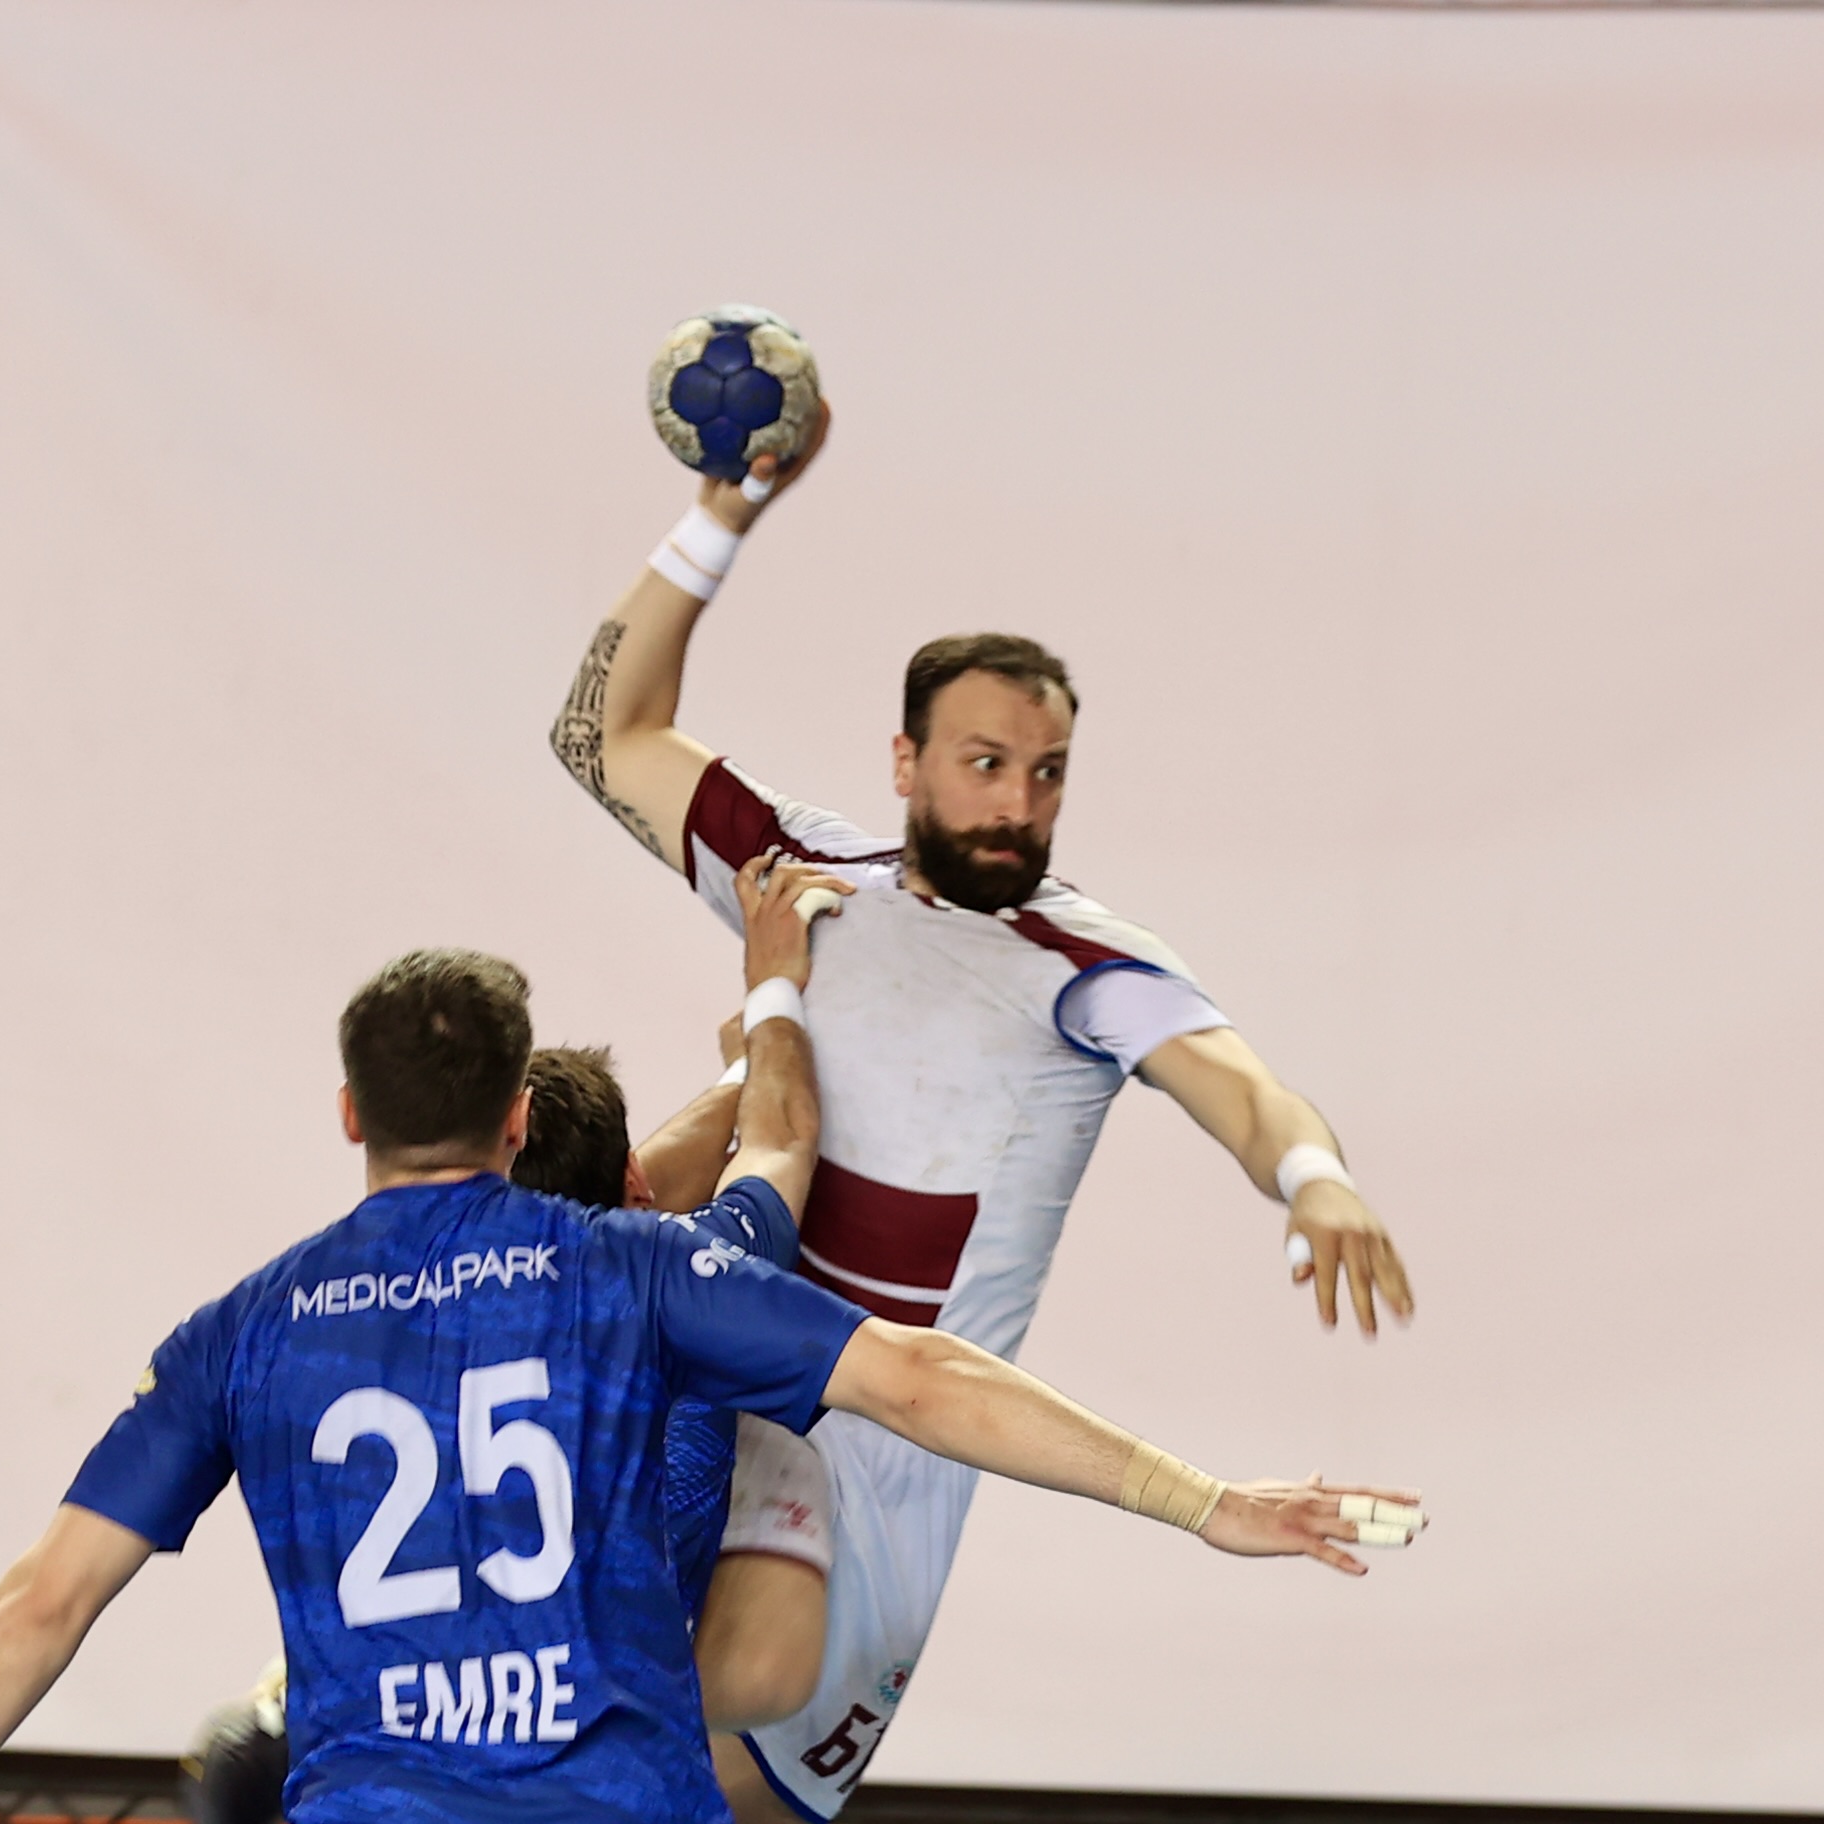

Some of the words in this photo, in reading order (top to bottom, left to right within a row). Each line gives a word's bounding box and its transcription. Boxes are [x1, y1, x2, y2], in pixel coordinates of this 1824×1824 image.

[292, 1242, 561, 1323] MEDICALPARK
[311, 1356, 576, 1631] 25
[379, 1643, 578, 1746] EMRE
